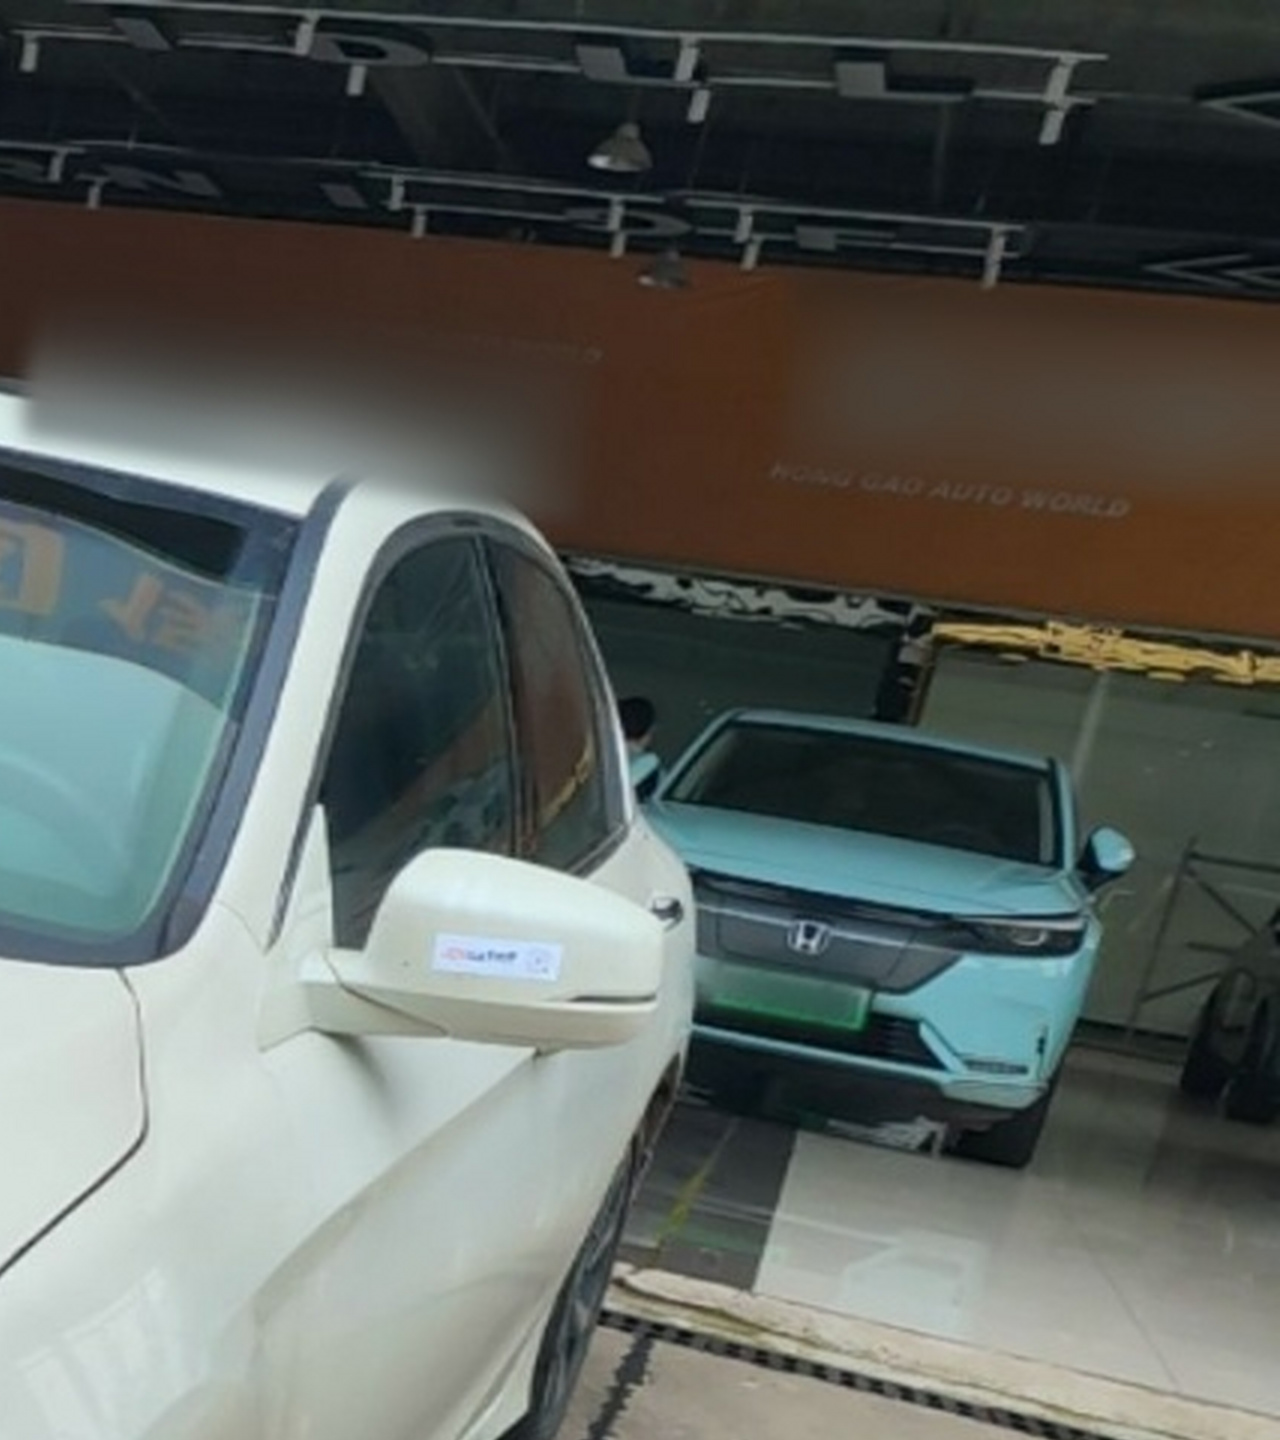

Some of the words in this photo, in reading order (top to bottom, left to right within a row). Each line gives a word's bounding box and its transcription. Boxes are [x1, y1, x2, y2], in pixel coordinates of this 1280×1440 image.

[860, 470, 925, 496] GAO
[929, 477, 1014, 507] AUTO
[1020, 487, 1132, 519] WORLD
